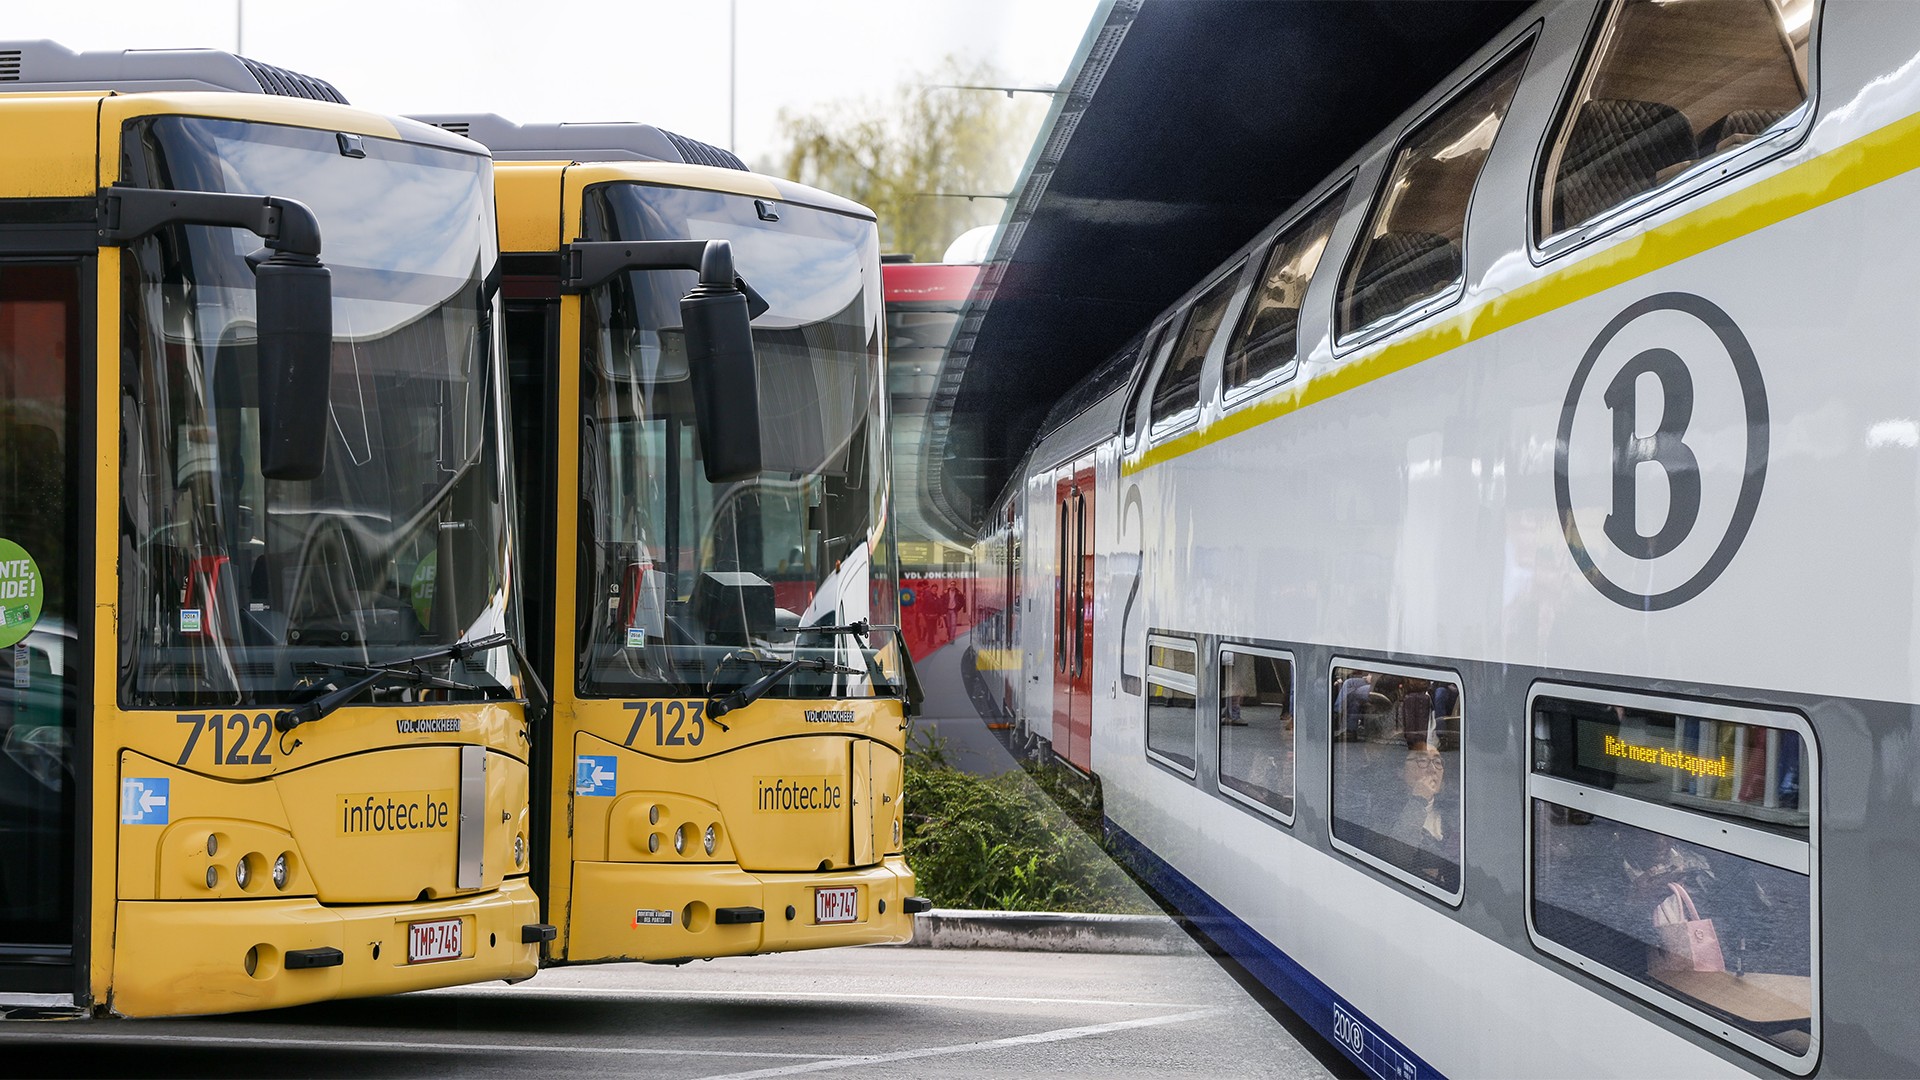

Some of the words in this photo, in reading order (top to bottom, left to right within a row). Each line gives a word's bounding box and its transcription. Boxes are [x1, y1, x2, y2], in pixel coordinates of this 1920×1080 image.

[415, 565, 436, 581] JE
[904, 571, 921, 579] VDL
[415, 583, 434, 599] JE
[1121, 483, 1144, 697] 2
[397, 719, 415, 733] VDL
[623, 701, 705, 746] 7123
[804, 710, 819, 723] VDL
[176, 713, 273, 765] 7122
[1605, 735, 1627, 757] Niet
[1629, 745, 1658, 763] meer
[1660, 747, 1726, 777] instappen!
[758, 779, 841, 810] infotec.be
[343, 794, 448, 833] infotec.be
[820, 892, 856, 919] TMP-747
[414, 924, 458, 957] TMP-746
[1334, 1009, 1350, 1043] 200
